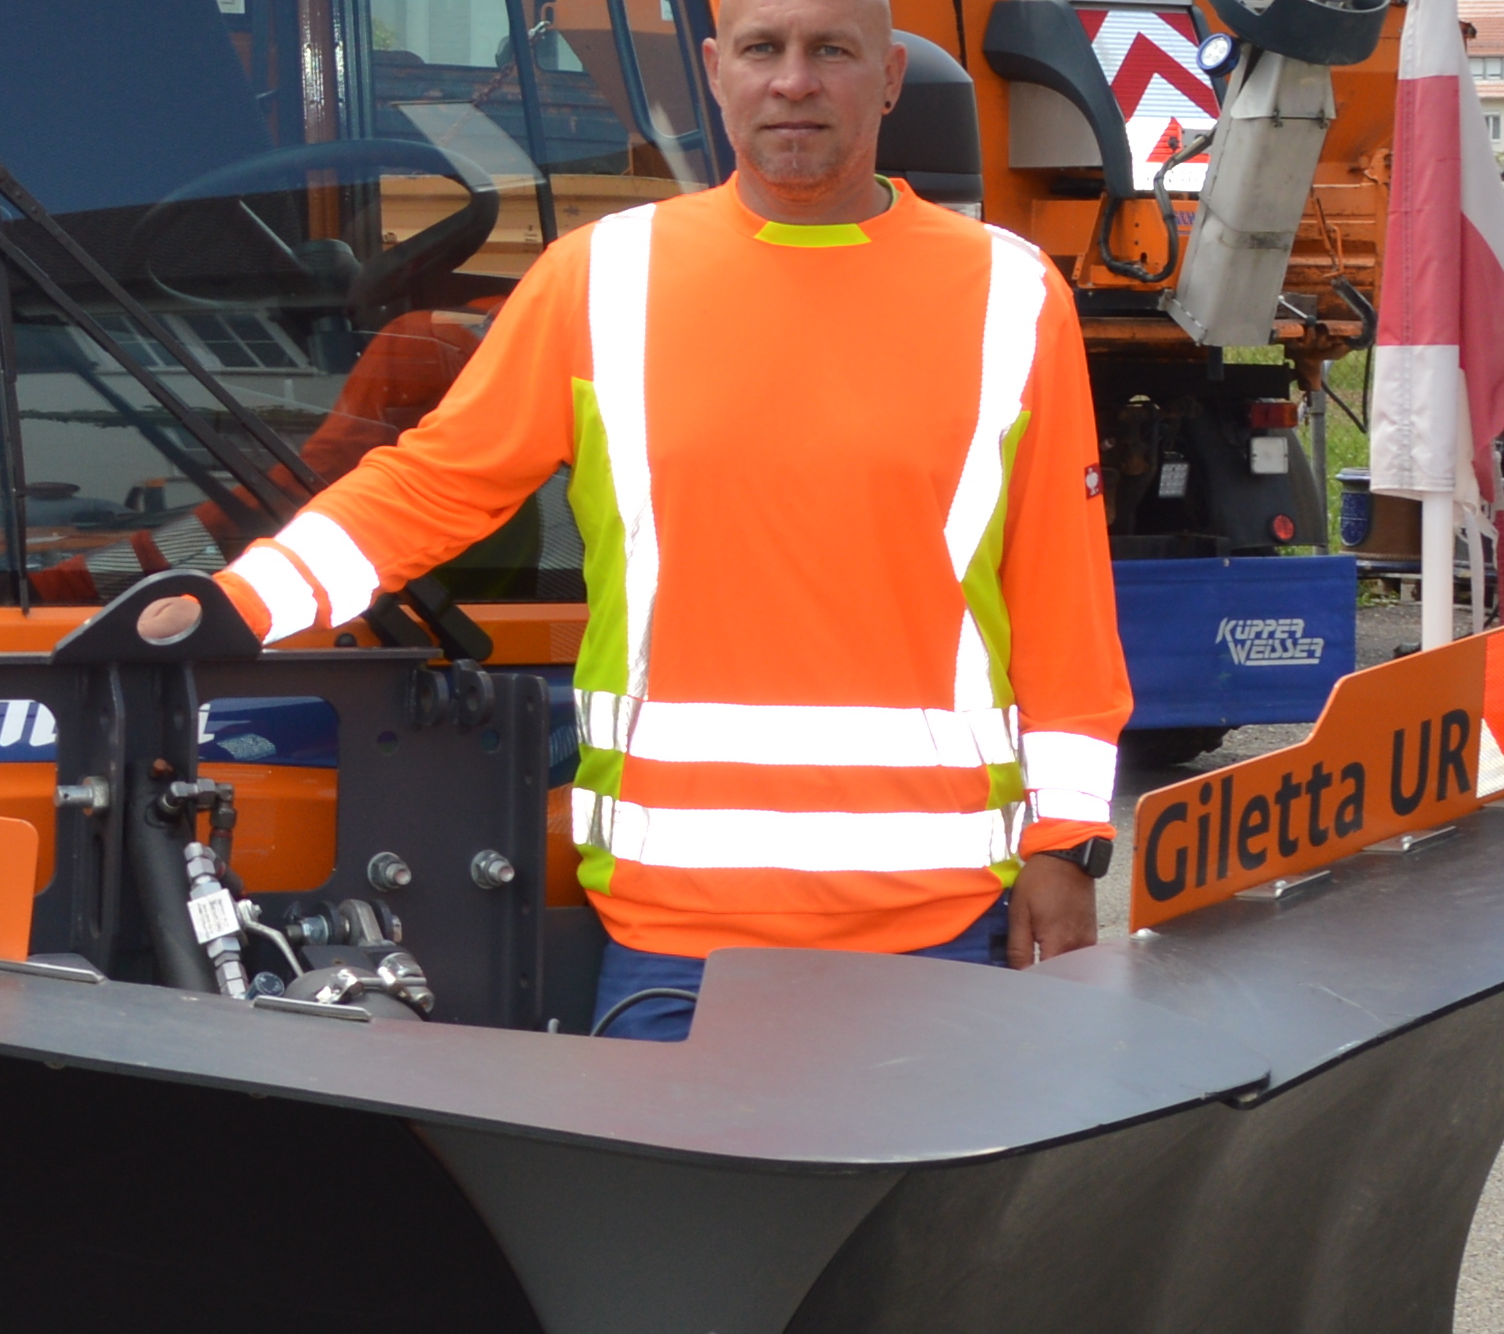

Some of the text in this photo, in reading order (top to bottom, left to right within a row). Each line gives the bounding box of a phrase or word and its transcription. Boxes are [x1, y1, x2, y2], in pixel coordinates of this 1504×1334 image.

[1215, 617, 1304, 644] KÜPPER
[1143, 708, 1473, 902] Giletta UR
